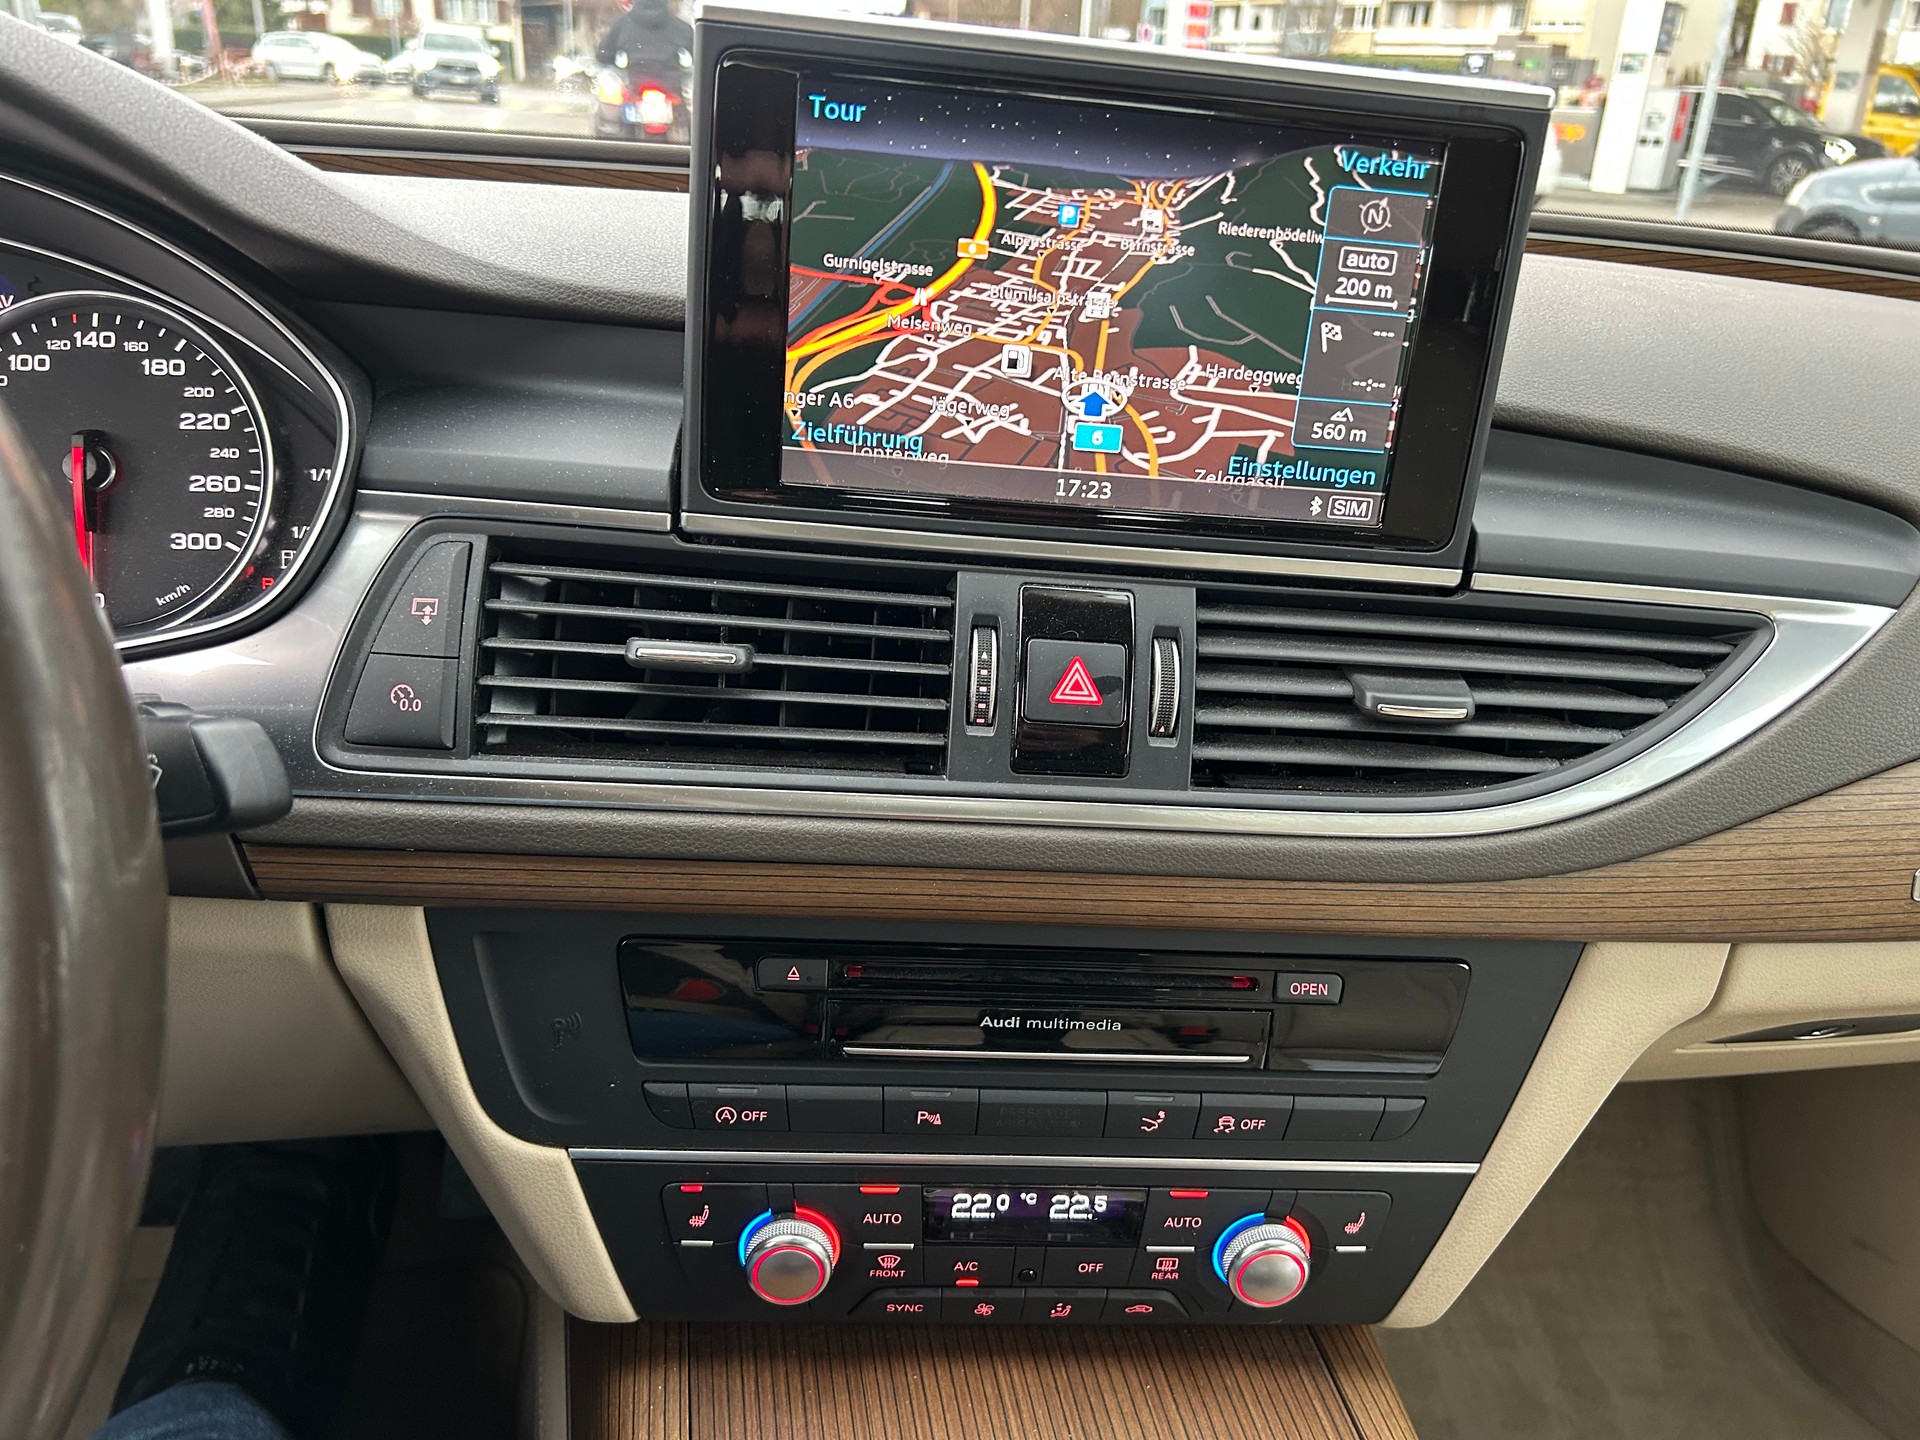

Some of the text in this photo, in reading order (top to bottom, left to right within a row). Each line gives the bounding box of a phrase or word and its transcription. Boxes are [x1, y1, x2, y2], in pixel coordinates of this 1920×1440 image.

[808, 94, 867, 122] Tour
[1342, 150, 1430, 180] Verkehr
[1062, 205, 1077, 223] P
[1368, 209, 1384, 225] N
[1001, 233, 1084, 252] Alpenstrasse
[1120, 238, 1196, 257] Bernstrasse
[823, 253, 934, 277] Gurnigelstrasse
[1346, 251, 1390, 270] auto
[1335, 278, 1393, 299] 200 m
[887, 315, 973, 337] Meisenweg
[46, 339, 71, 351] 120
[73, 331, 116, 349] 140
[123, 341, 149, 352] 160
[8, 354, 51, 371] 100
[141, 359, 186, 376] 180
[1206, 363, 1302, 389] Hardeggweg
[184, 387, 215, 398] 200
[829, 392, 855, 409] A6
[930, 395, 1010, 420] Jägerweg
[179, 413, 231, 431] 220
[792, 421, 923, 456] Zielführung
[1092, 430, 1104, 445] 6
[1311, 423, 1367, 443] 560 m
[210, 449, 240, 459] 240
[309, 468, 332, 482] 1/1
[1228, 456, 1376, 488] Einstellungen
[189, 475, 241, 493] 260
[1055, 478, 1113, 499] 17:23
[204, 508, 235, 518] 280
[1333, 500, 1368, 517] SIM
[170, 533, 223, 551] 300
[156, 584, 191, 606] km/h
[400, 698, 422, 712] 0.0
[1290, 982, 1329, 997] OPEN
[980, 1015, 1122, 1032] Audi multimedia
[741, 1111, 768, 1122] OFF
[1240, 1118, 1266, 1131] OFF
[951, 1193, 1011, 1219] 22.0
[1049, 1194, 1108, 1220] 22.5
[863, 1213, 902, 1225] AUTO
[1164, 1217, 1202, 1229] AUTO
[870, 1269, 906, 1278] FRONT
[954, 1261, 979, 1272] A/C
[1078, 1263, 1104, 1274] OFF
[1151, 1272, 1180, 1280] REAR
[887, 1303, 924, 1313] SYNC
